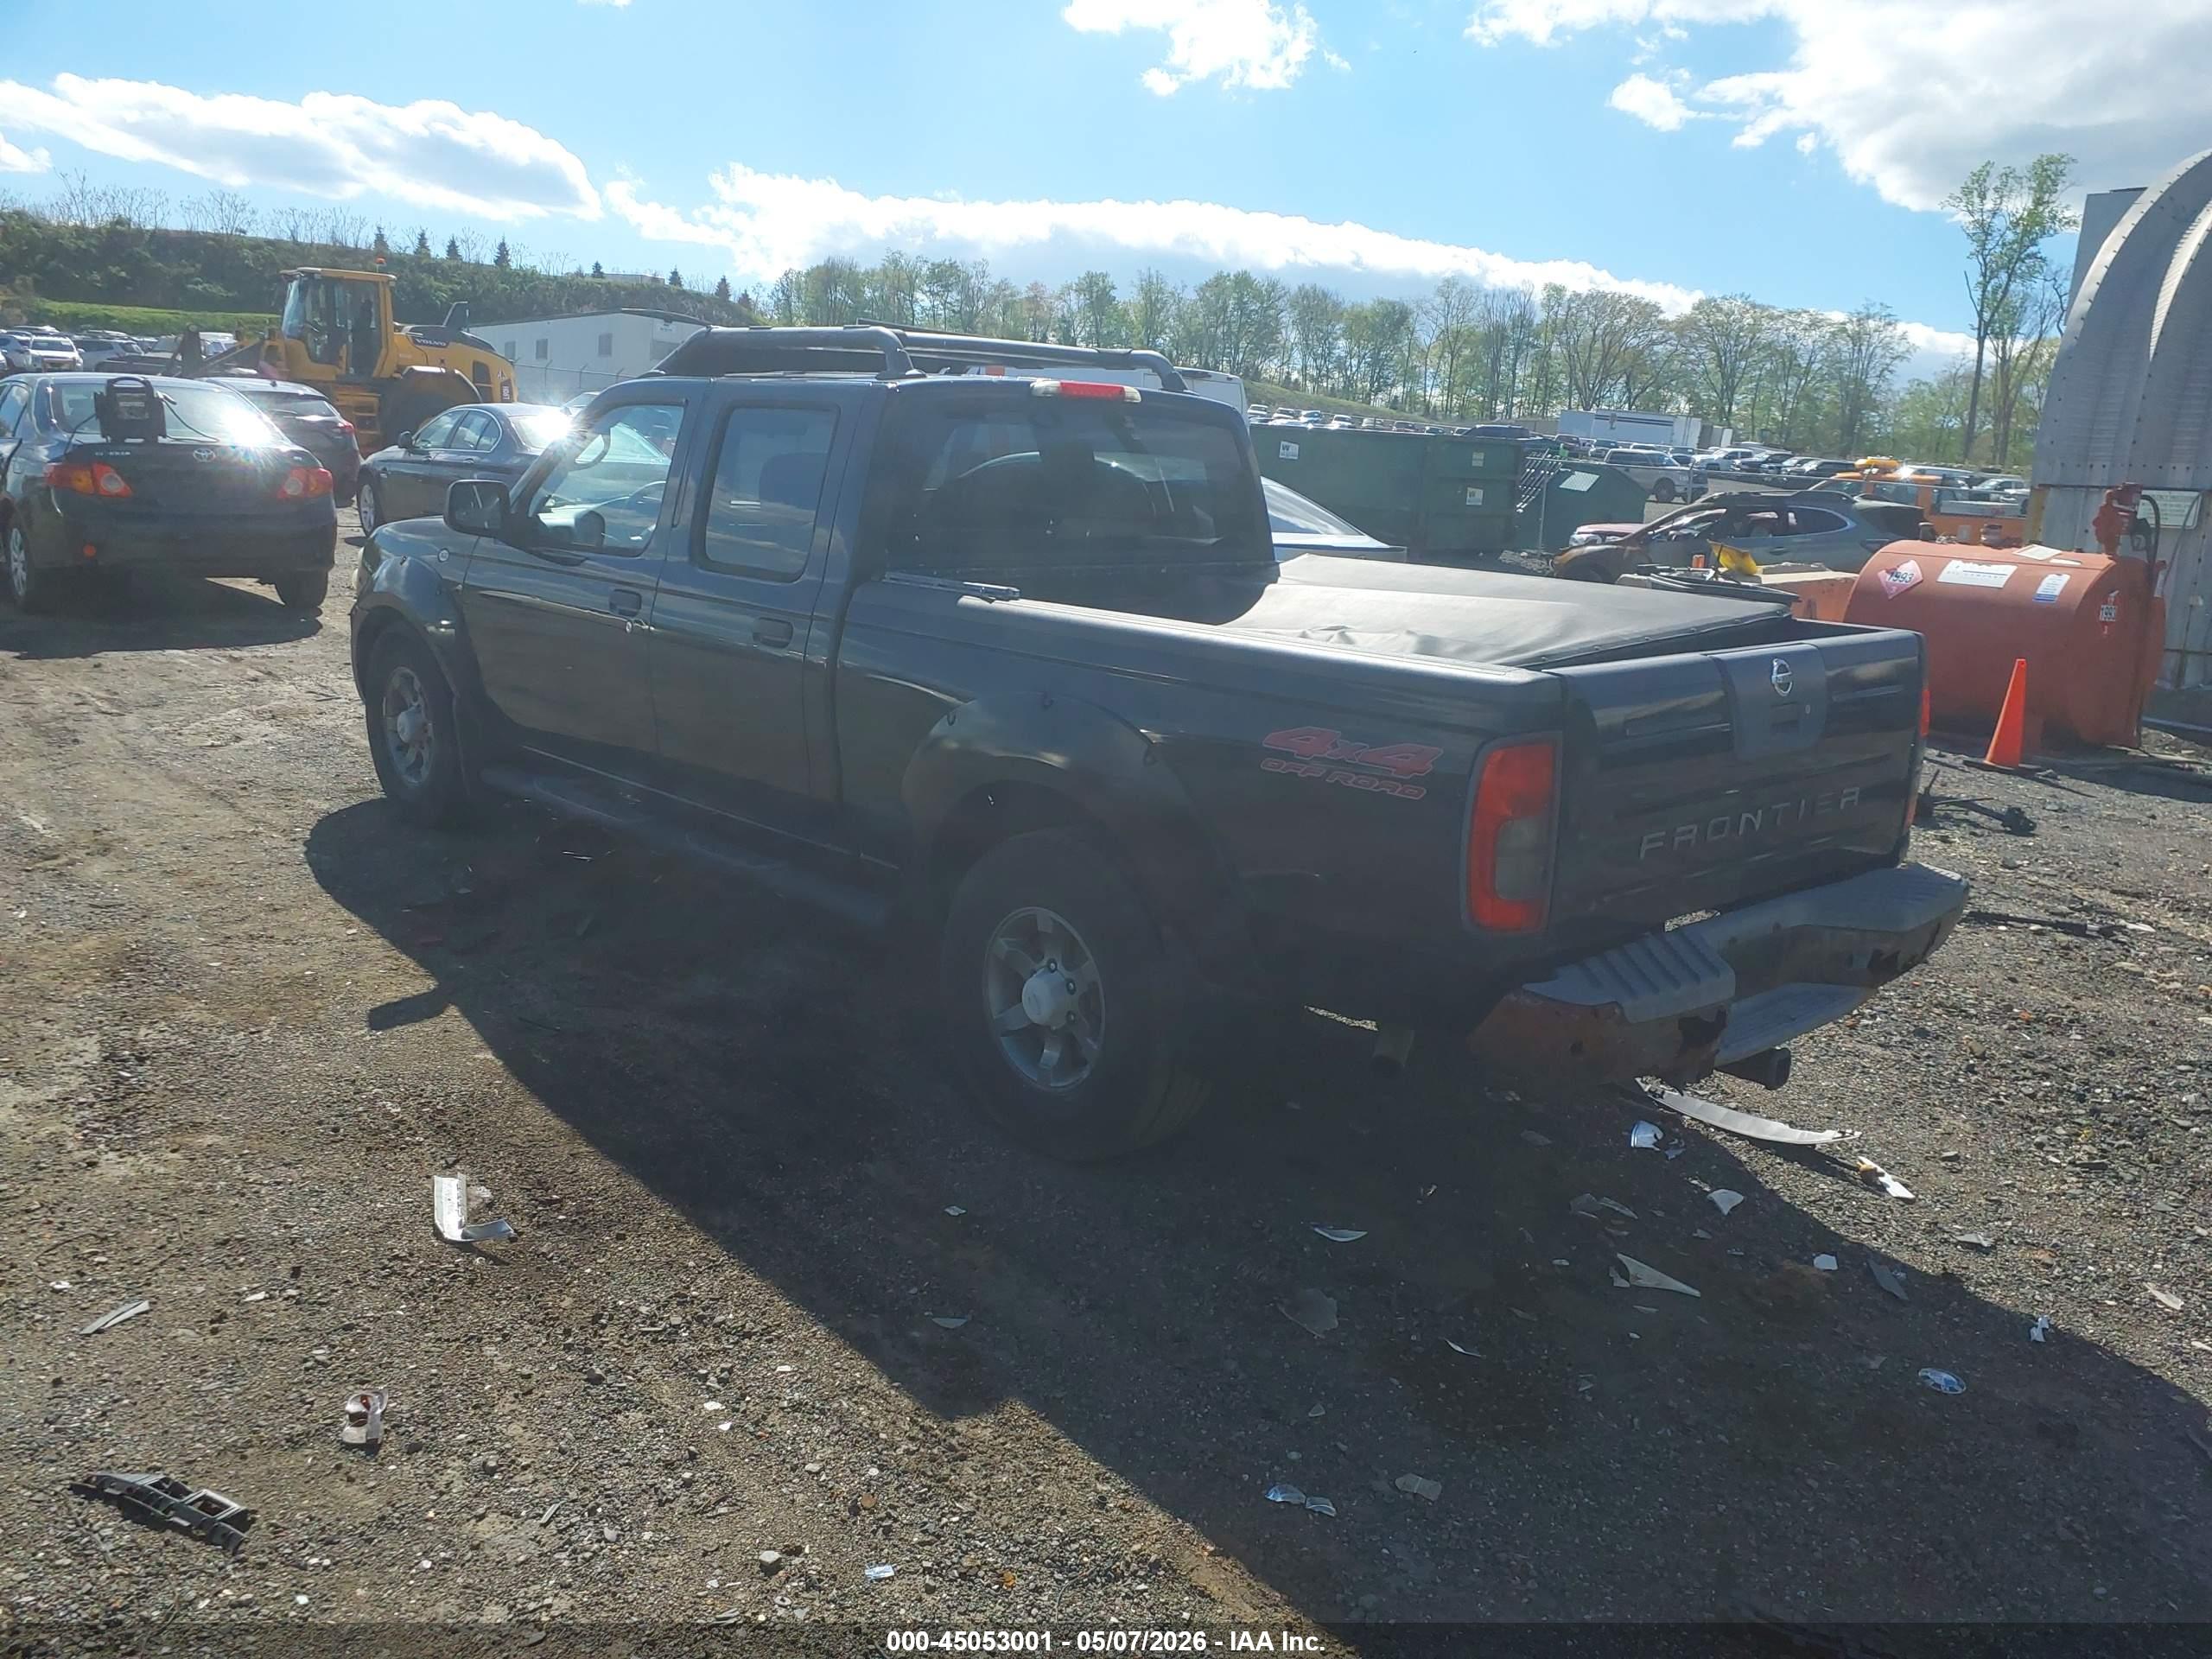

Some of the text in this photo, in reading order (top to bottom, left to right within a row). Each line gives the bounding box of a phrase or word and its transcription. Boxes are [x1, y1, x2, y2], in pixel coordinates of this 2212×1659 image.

[416, 338, 447, 346] VOLVO
[1888, 571, 1915, 584] 1993
[1260, 757, 1427, 800] OFF ROAD
[1639, 786, 1860, 861] FRONTIER
